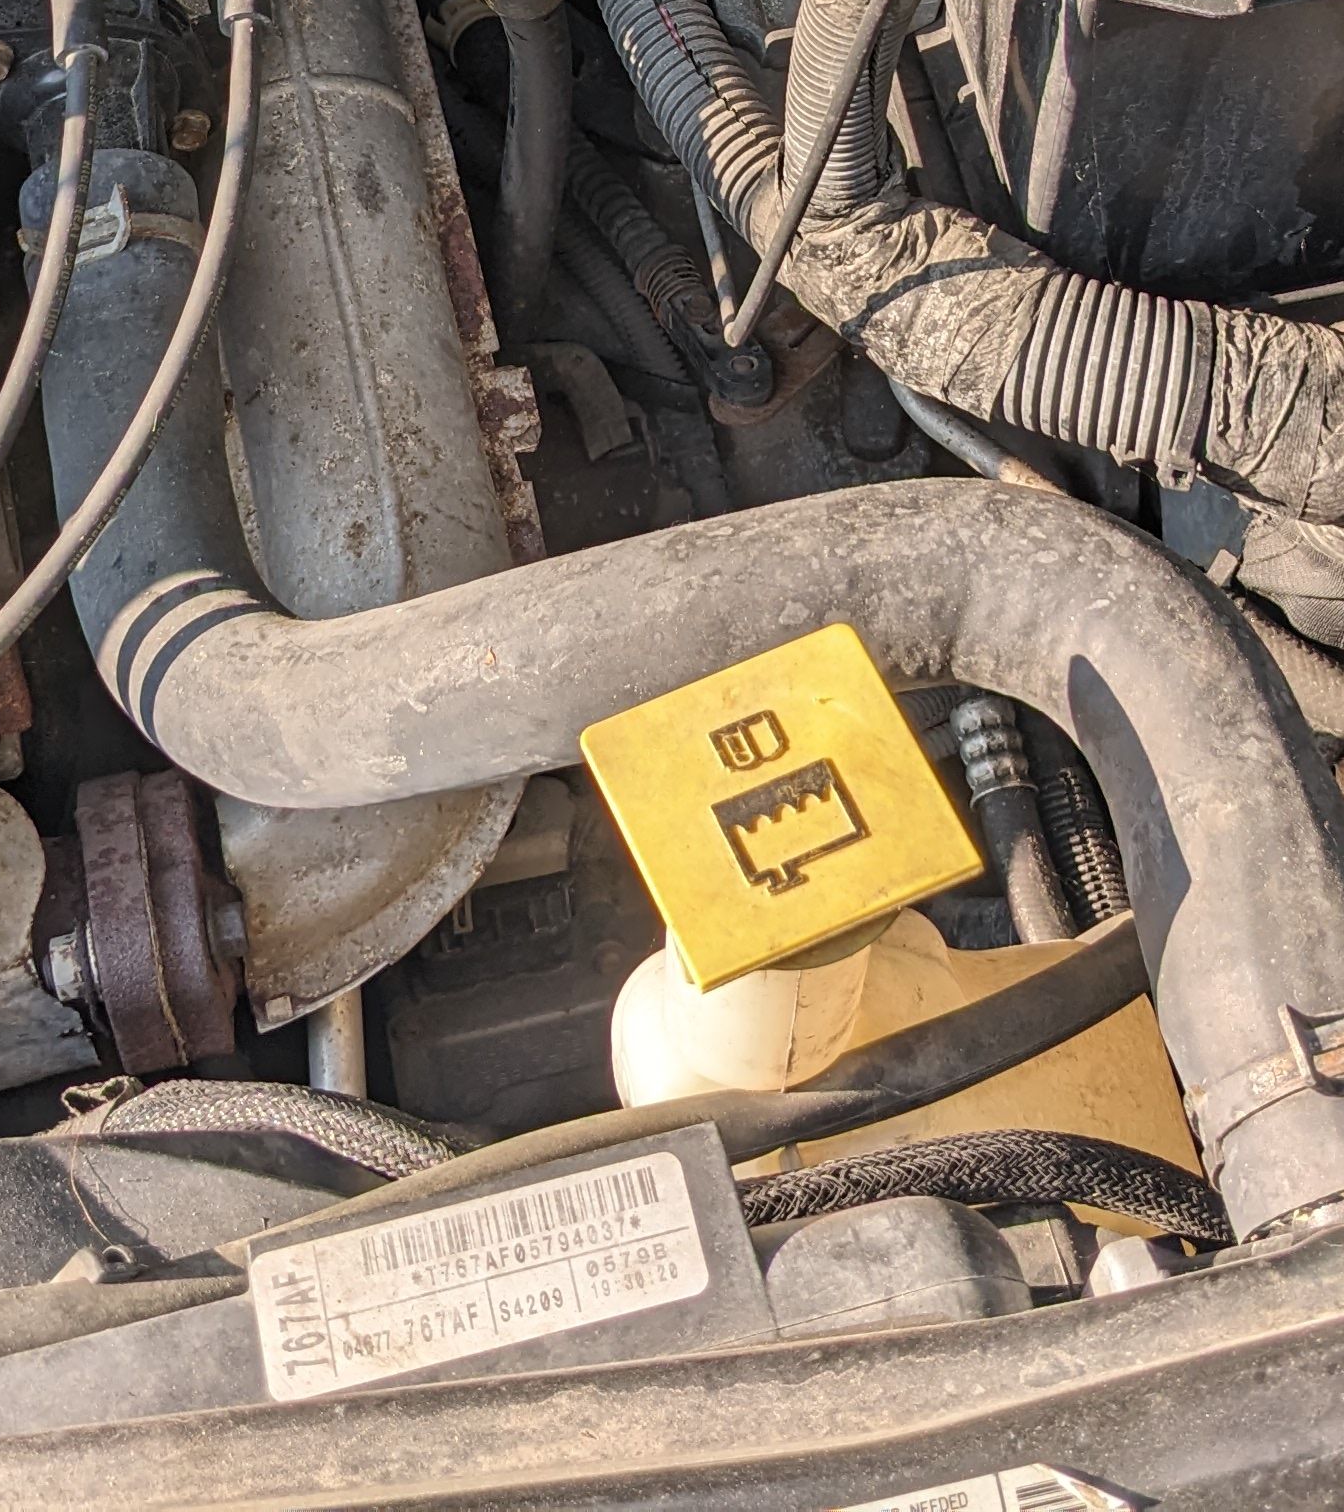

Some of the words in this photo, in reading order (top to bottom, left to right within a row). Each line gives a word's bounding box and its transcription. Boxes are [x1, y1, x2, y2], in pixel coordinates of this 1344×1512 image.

[271, 1269, 332, 1377] 767AF
[404, 1301, 482, 1345] 767AF
[499, 1287, 566, 1323] S4209
[909, 1491, 969, 1512] NEEDED
